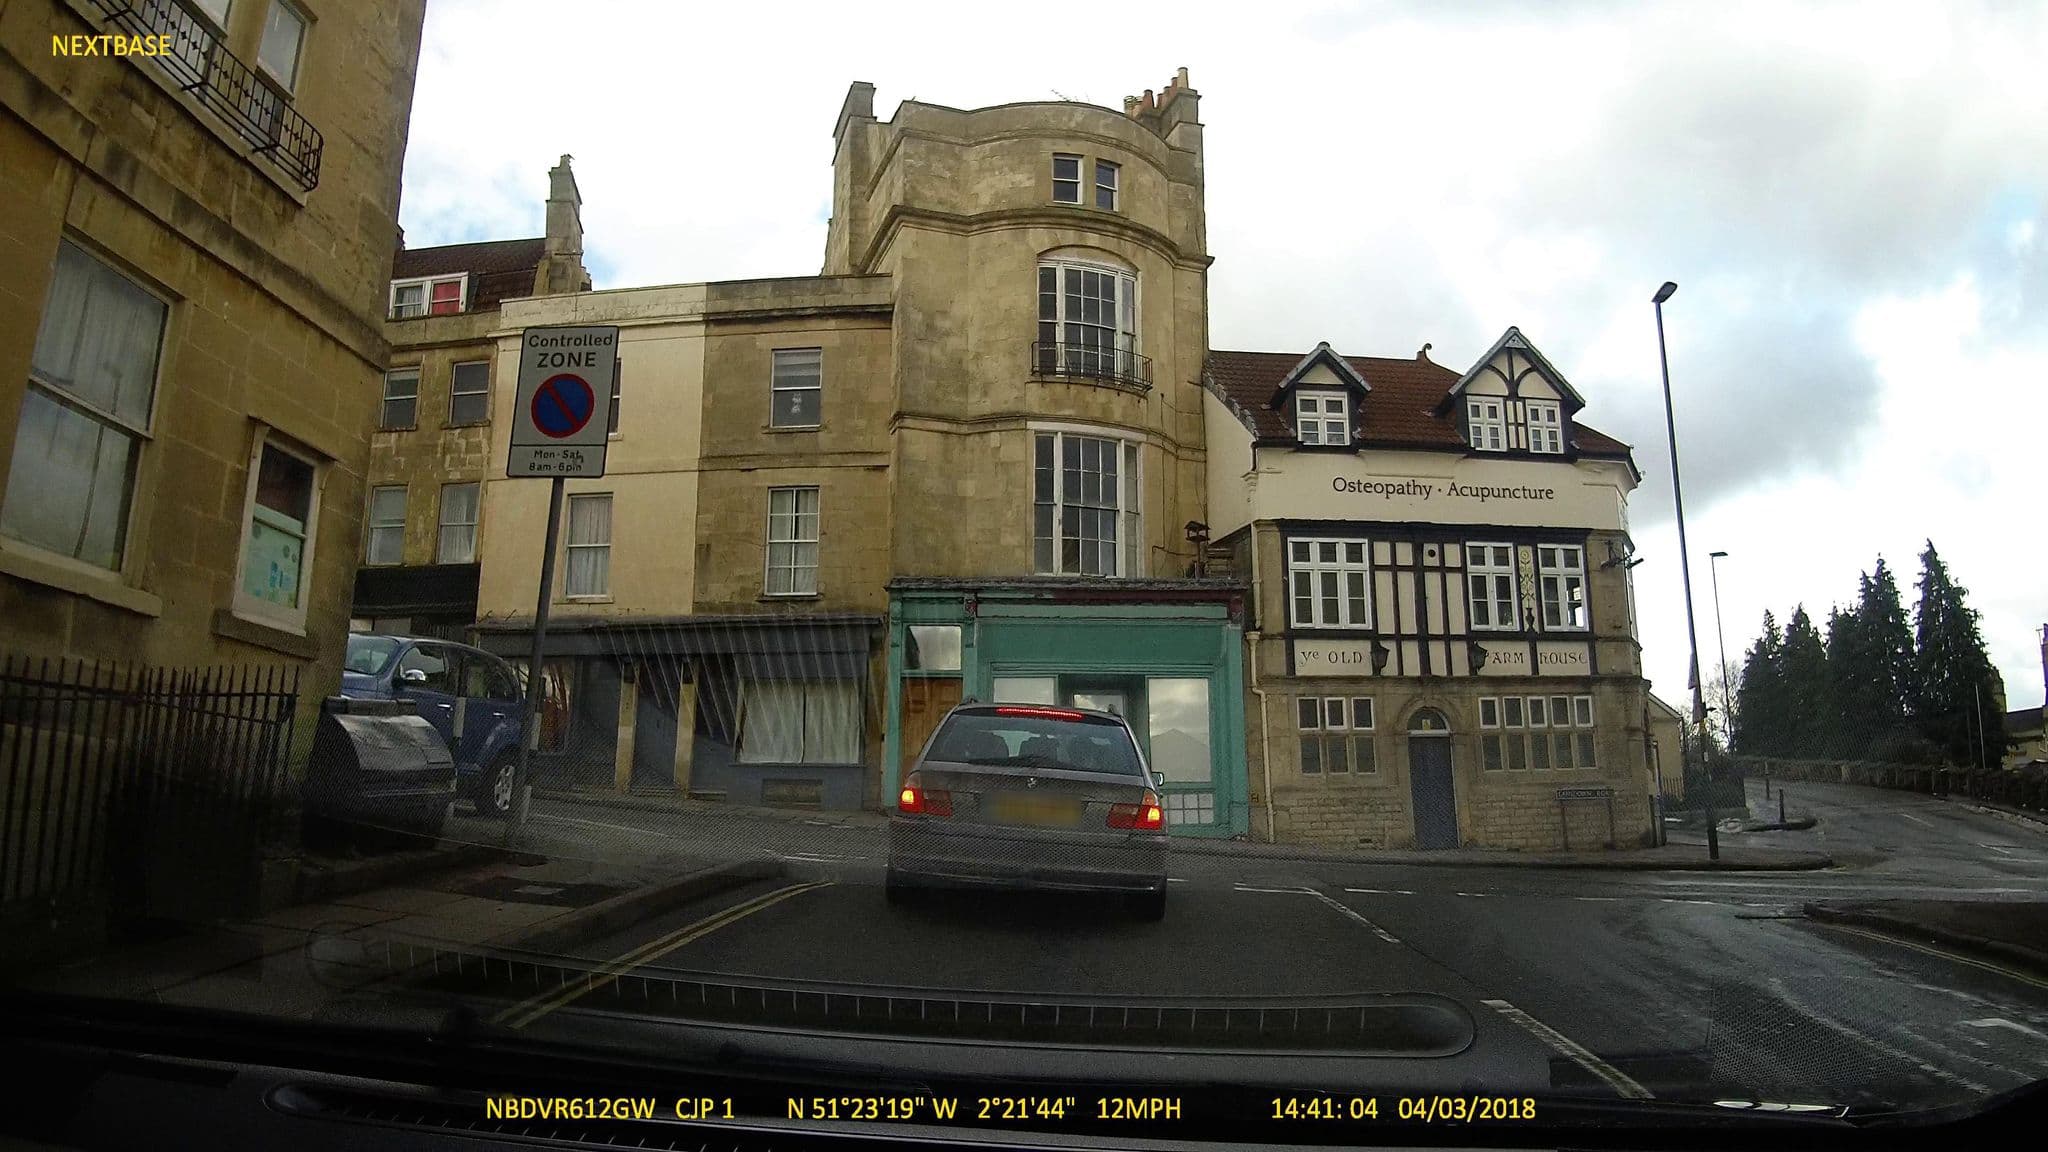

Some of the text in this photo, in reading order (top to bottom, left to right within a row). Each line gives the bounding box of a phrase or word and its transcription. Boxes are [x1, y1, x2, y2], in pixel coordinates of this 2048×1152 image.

[528, 333, 613, 348] Controlled
[536, 351, 597, 368] ZONE
[1332, 476, 1433, 501] Osteopathy
[1446, 481, 1555, 502] Acupuncture
[1327, 650, 1364, 665] OLD
[1483, 650, 1525, 665] ARM
